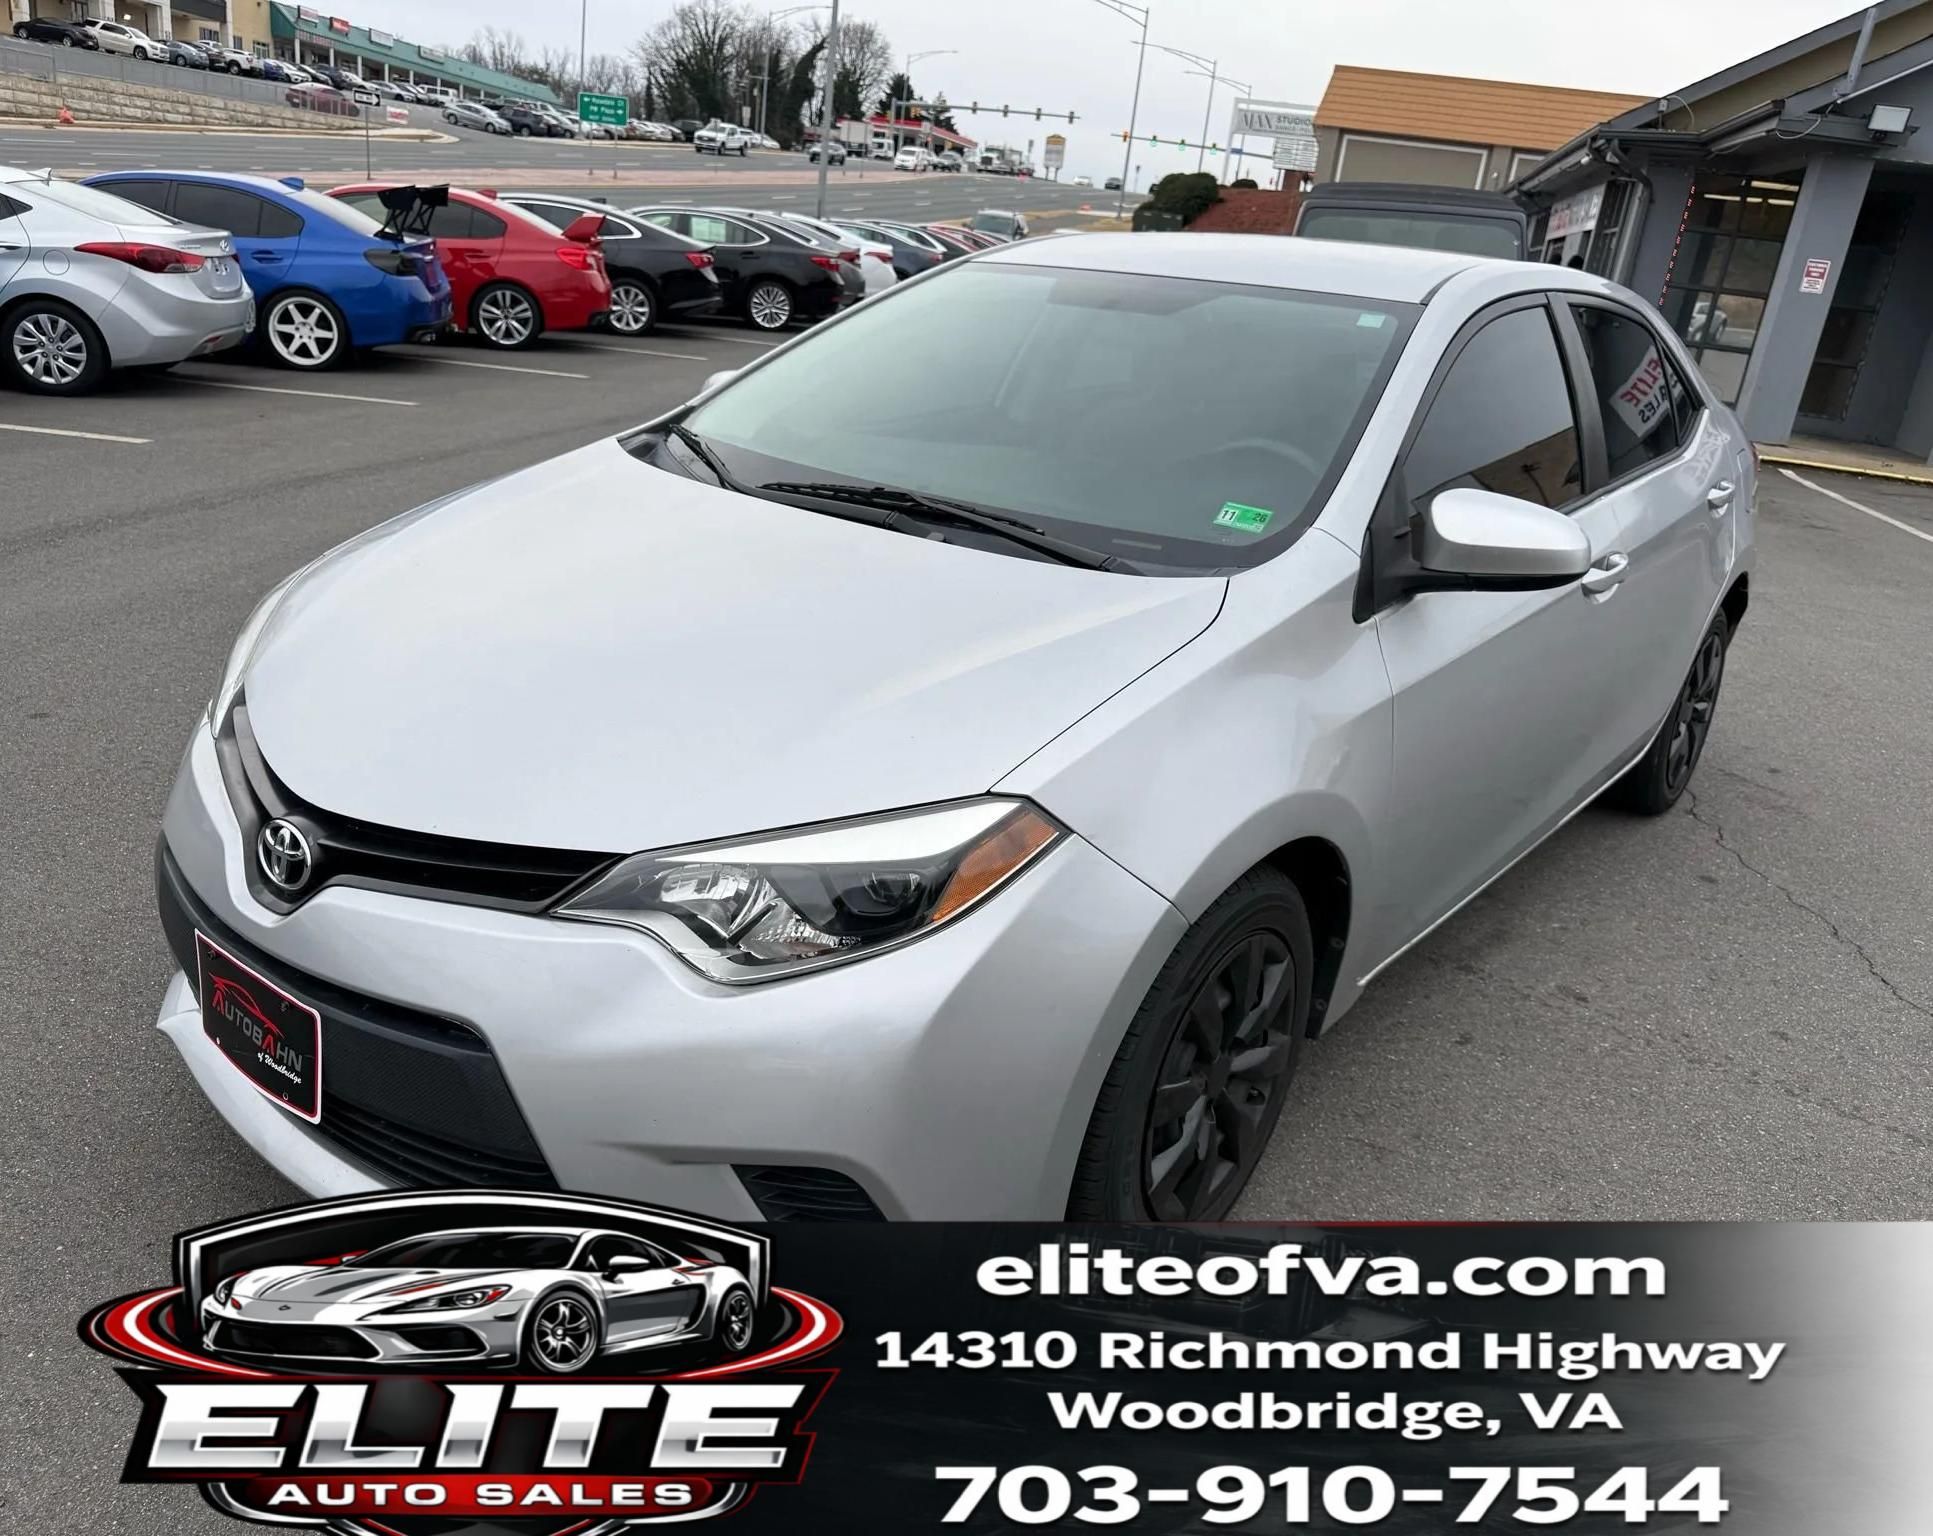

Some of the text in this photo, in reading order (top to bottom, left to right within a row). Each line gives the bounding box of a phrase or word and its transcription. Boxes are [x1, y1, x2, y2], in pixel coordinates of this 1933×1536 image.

[1222, 510, 1236, 521] 11
[212, 990, 302, 1072] AUTOBAHN
[265, 1055, 302, 1084] Woodbridge
